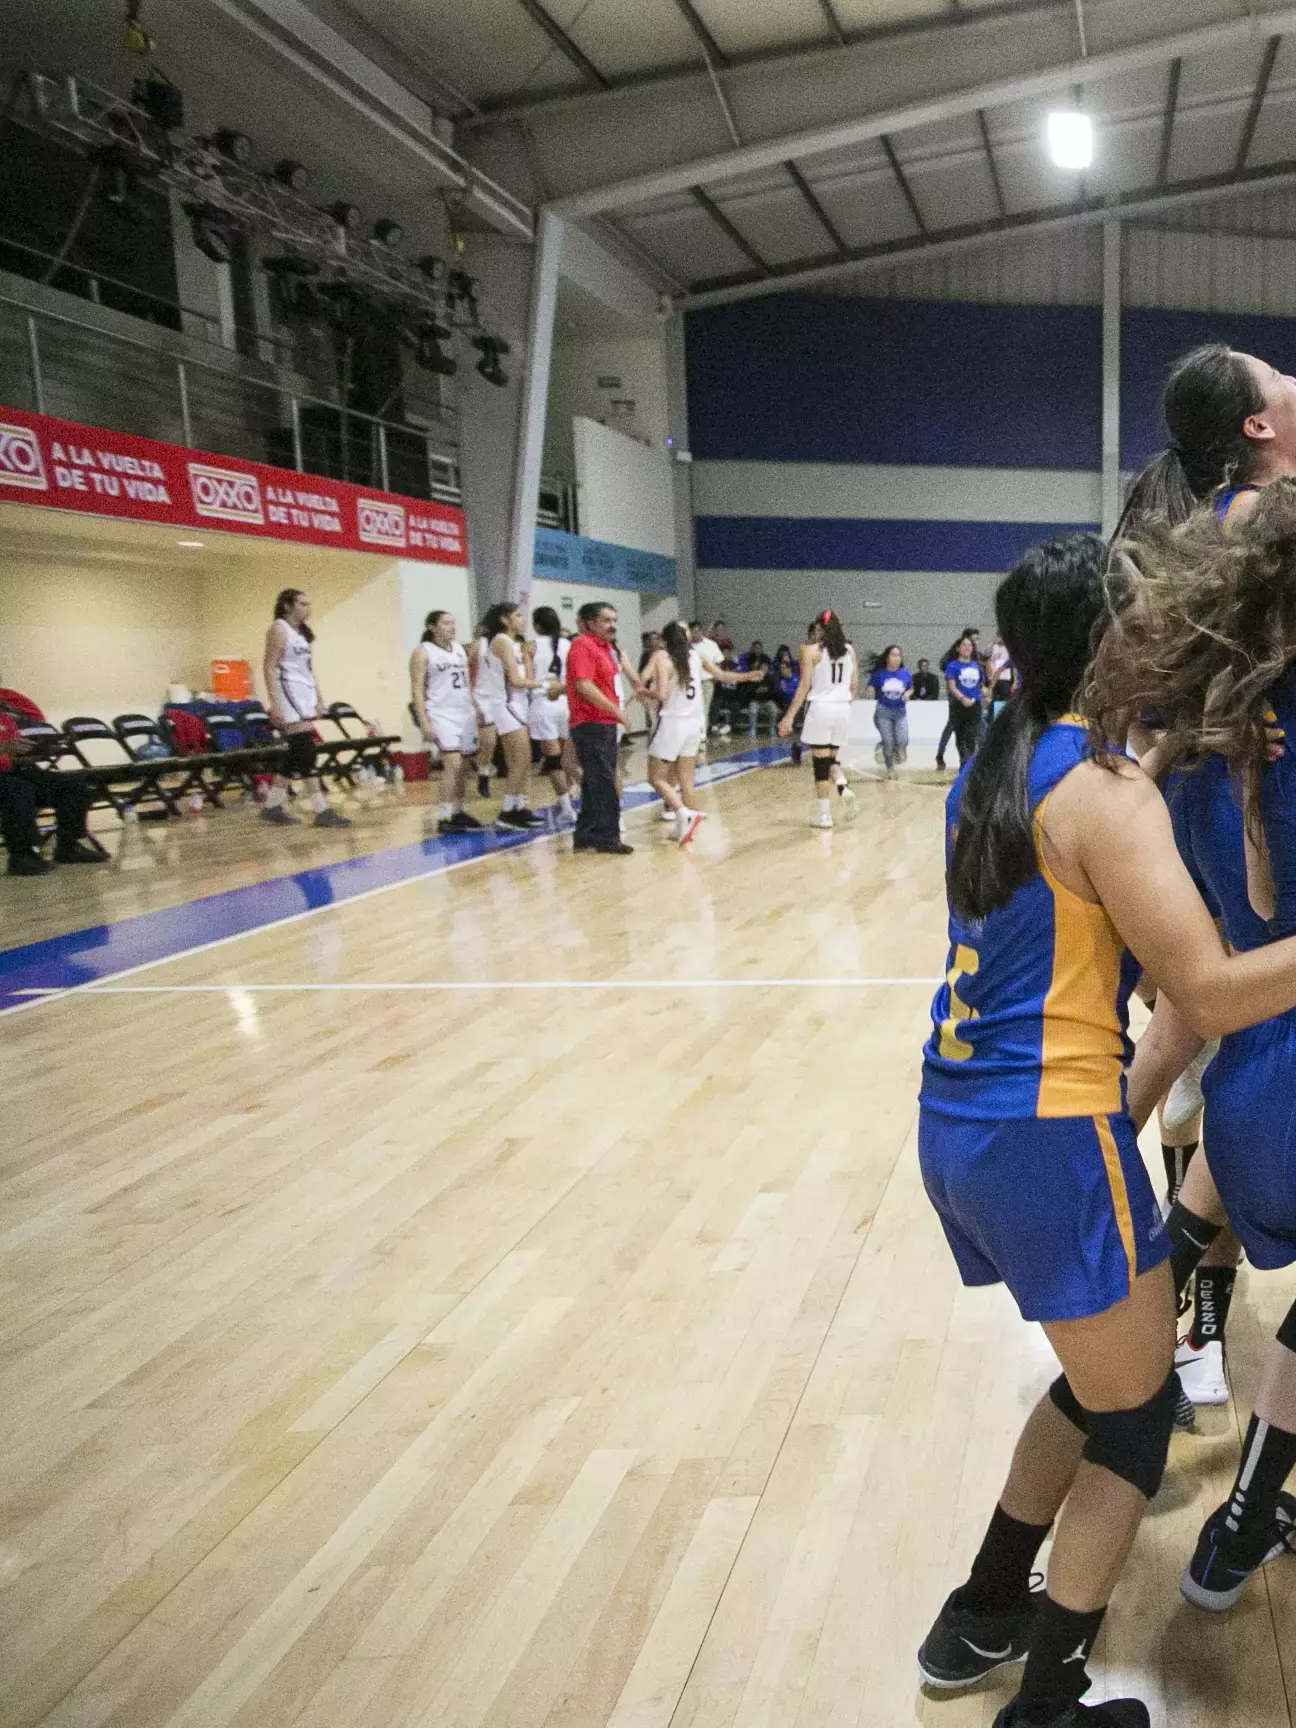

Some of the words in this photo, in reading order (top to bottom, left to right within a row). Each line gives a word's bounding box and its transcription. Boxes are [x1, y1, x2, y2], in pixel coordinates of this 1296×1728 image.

[52, 441, 67, 461] A
[69, 445, 97, 467] LA
[96, 451, 165, 479] VUELTA
[55, 465, 88, 491] DE
[89, 472, 119, 496] TU
[122, 479, 172, 504] VIDA
[197, 476, 258, 511] OXXO
[265, 484, 275, 500] A
[277, 488, 295, 504] LA
[295, 491, 341, 513] VUELTA
[267, 504, 289, 524] DE
[289, 508, 310, 528] TU
[311, 512, 343, 532] VIDA
[361, 508, 402, 537] OXXO
[830, 662, 844, 684] 11
